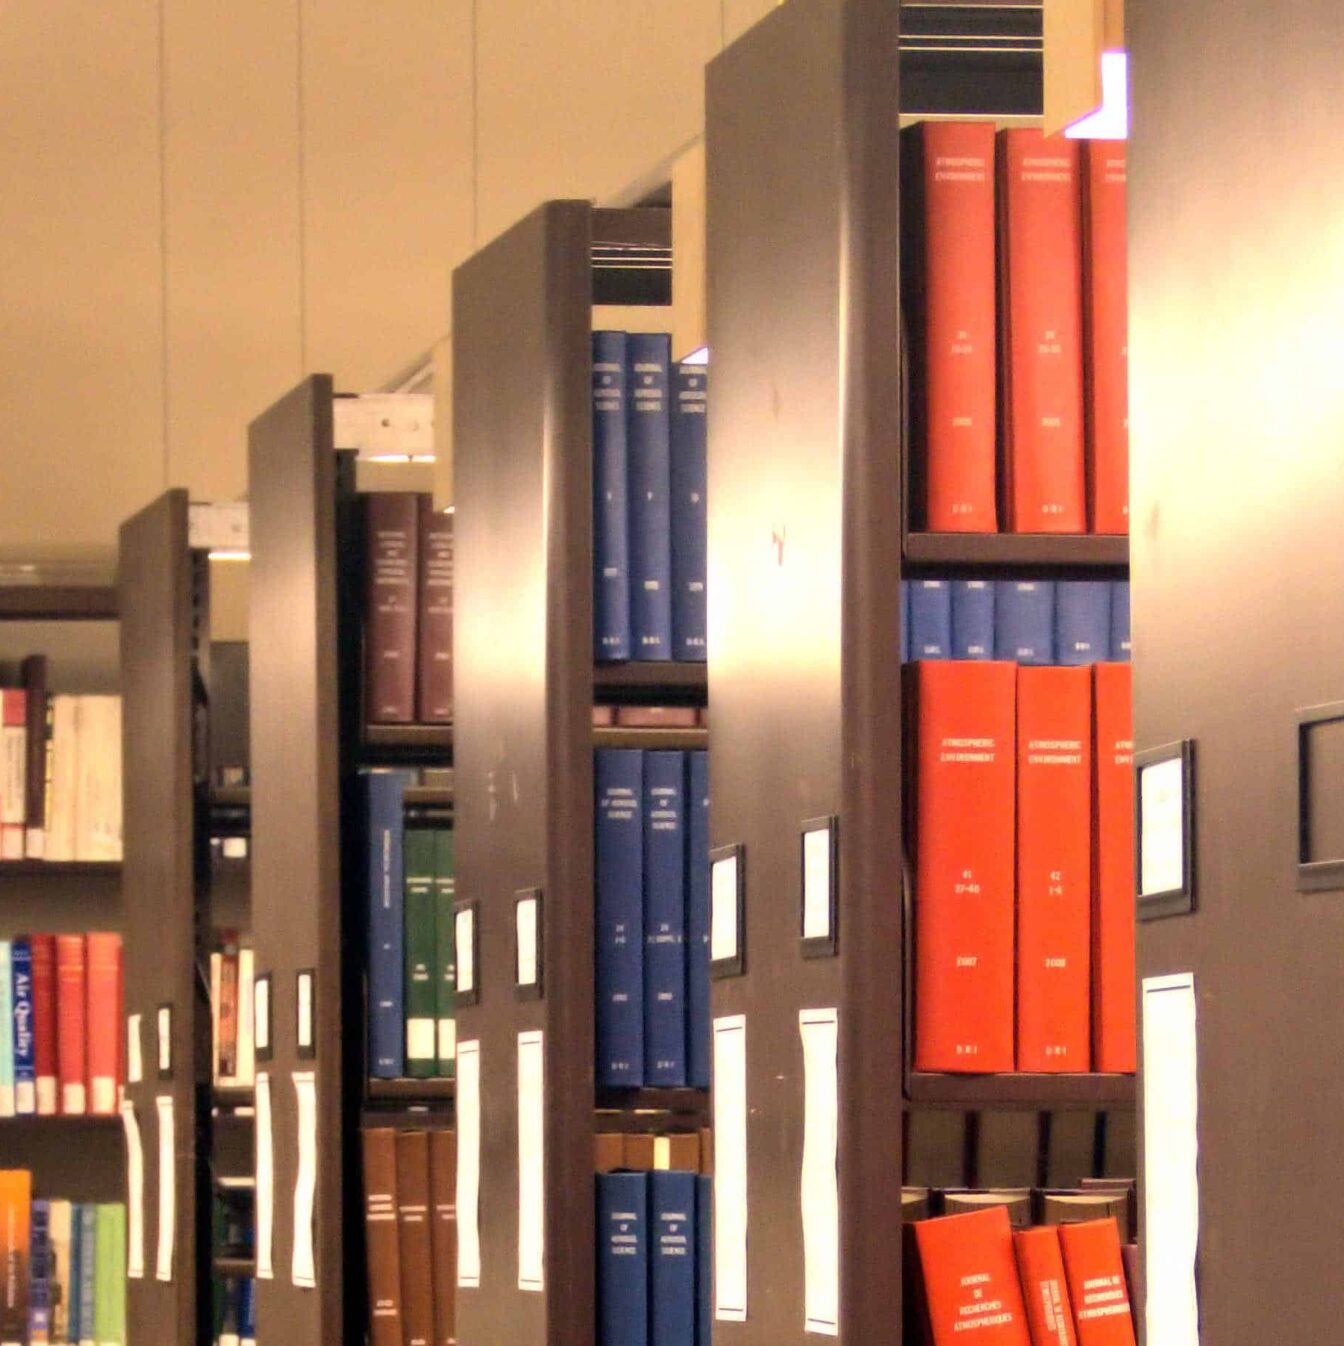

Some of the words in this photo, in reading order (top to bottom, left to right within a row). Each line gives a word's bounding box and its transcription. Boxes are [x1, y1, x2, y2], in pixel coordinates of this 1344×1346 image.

[1028, 740, 1081, 750] ATMOSPHERIC
[16, 972, 31, 998] Air
[14, 1001, 31, 1057] Quality
